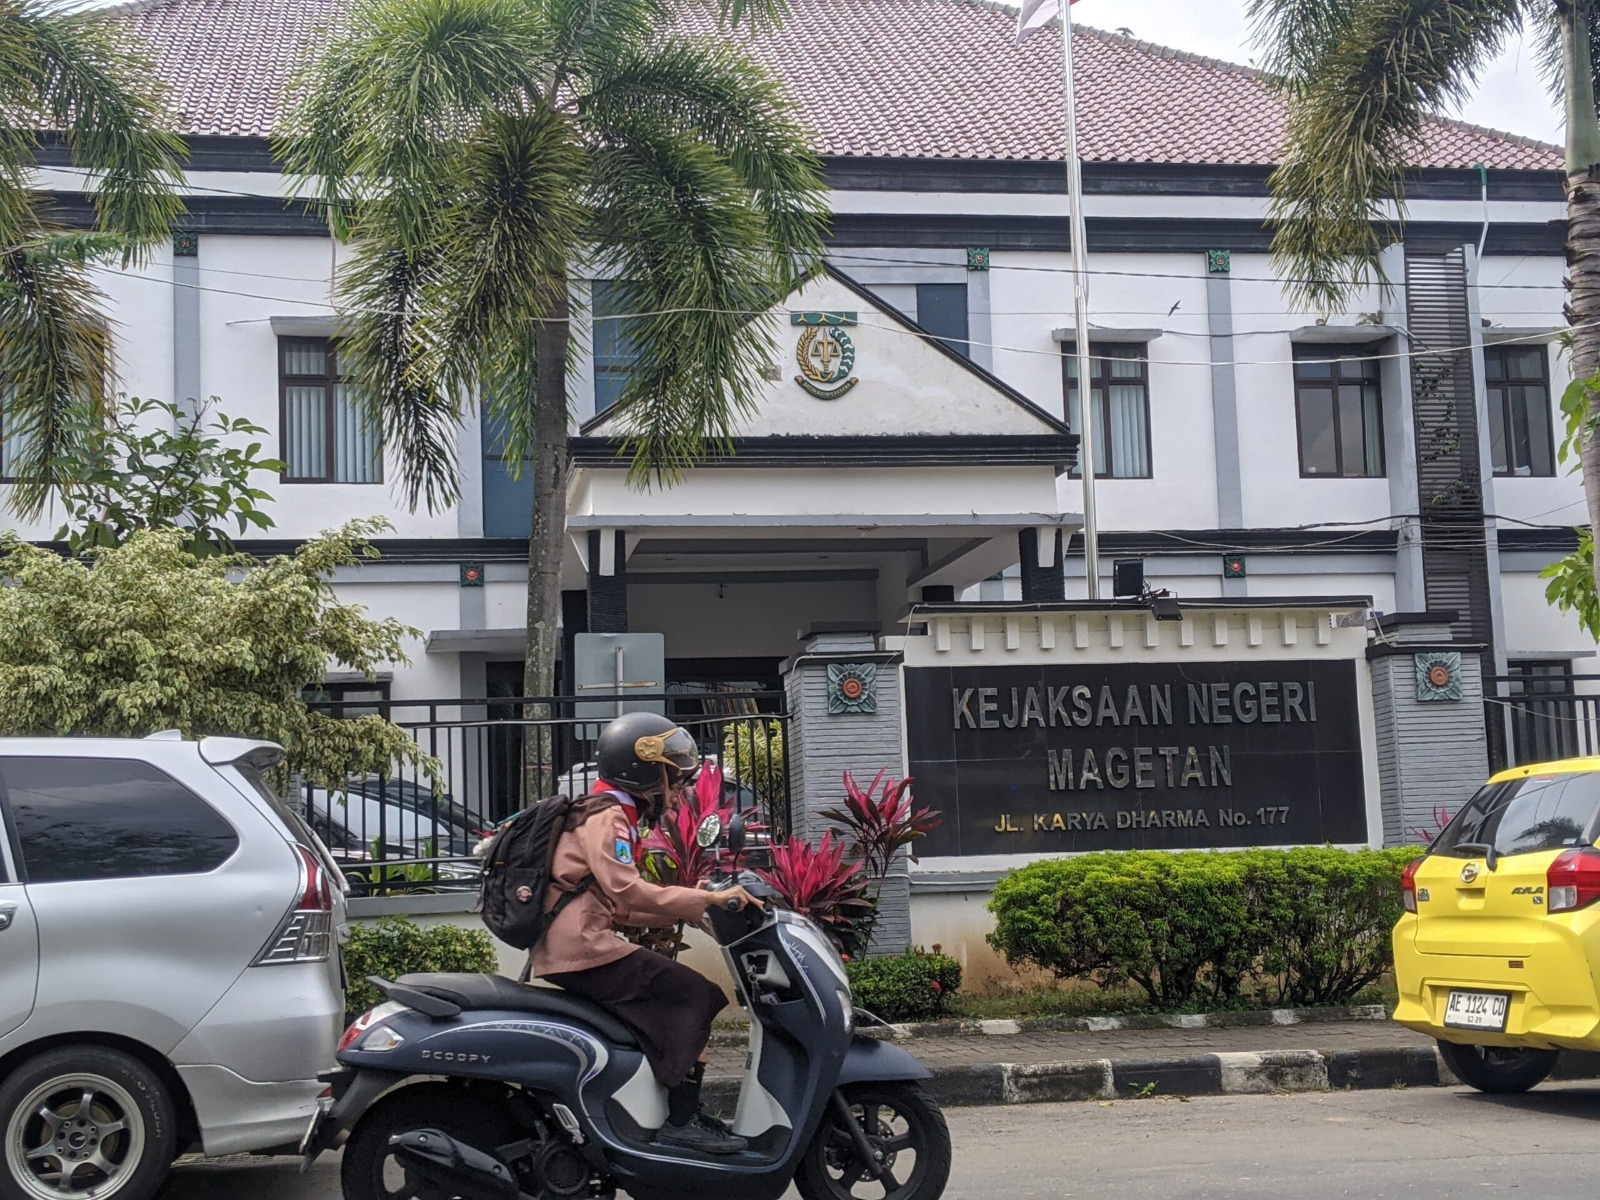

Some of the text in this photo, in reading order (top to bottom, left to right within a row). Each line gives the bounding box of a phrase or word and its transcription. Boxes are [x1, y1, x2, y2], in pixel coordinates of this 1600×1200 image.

[952, 681, 1317, 729] KEJAKSAAN NEGERI
[1047, 745, 1232, 791] MAGETAN
[994, 806, 1290, 832] JL. KARYA DHARMA No. 177
[1449, 994, 1462, 1012] AE
[1465, 995, 1488, 1015] 1124
[421, 1050, 491, 1063] SCOOPY
